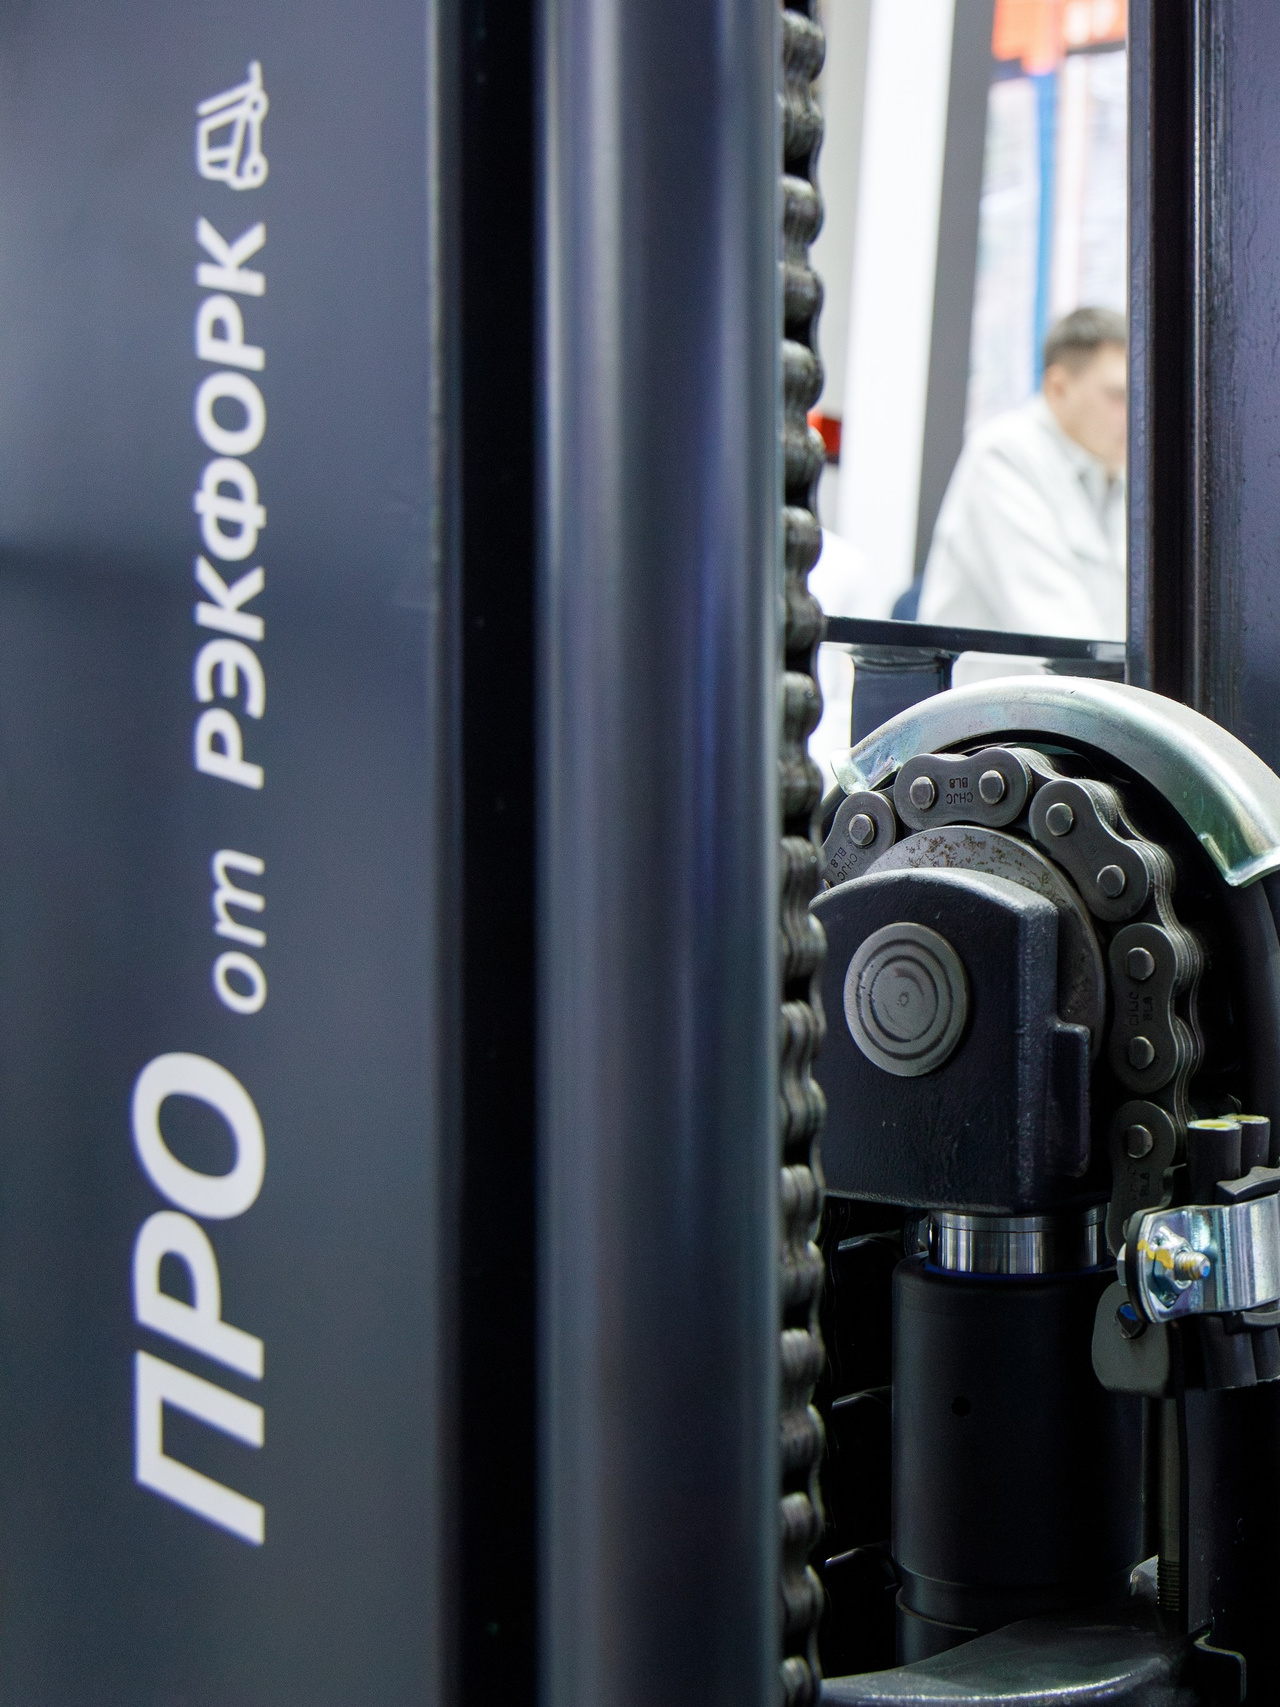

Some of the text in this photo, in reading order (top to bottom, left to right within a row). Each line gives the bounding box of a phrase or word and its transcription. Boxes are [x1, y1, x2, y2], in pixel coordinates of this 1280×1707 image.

[949, 777, 969, 789] BL8
[945, 792, 974, 805] CHJC
[830, 847, 847, 869] BL8
[836, 853, 858, 881] CHJC
[132, 216, 267, 1544] ПРО от РЭКФОРК
